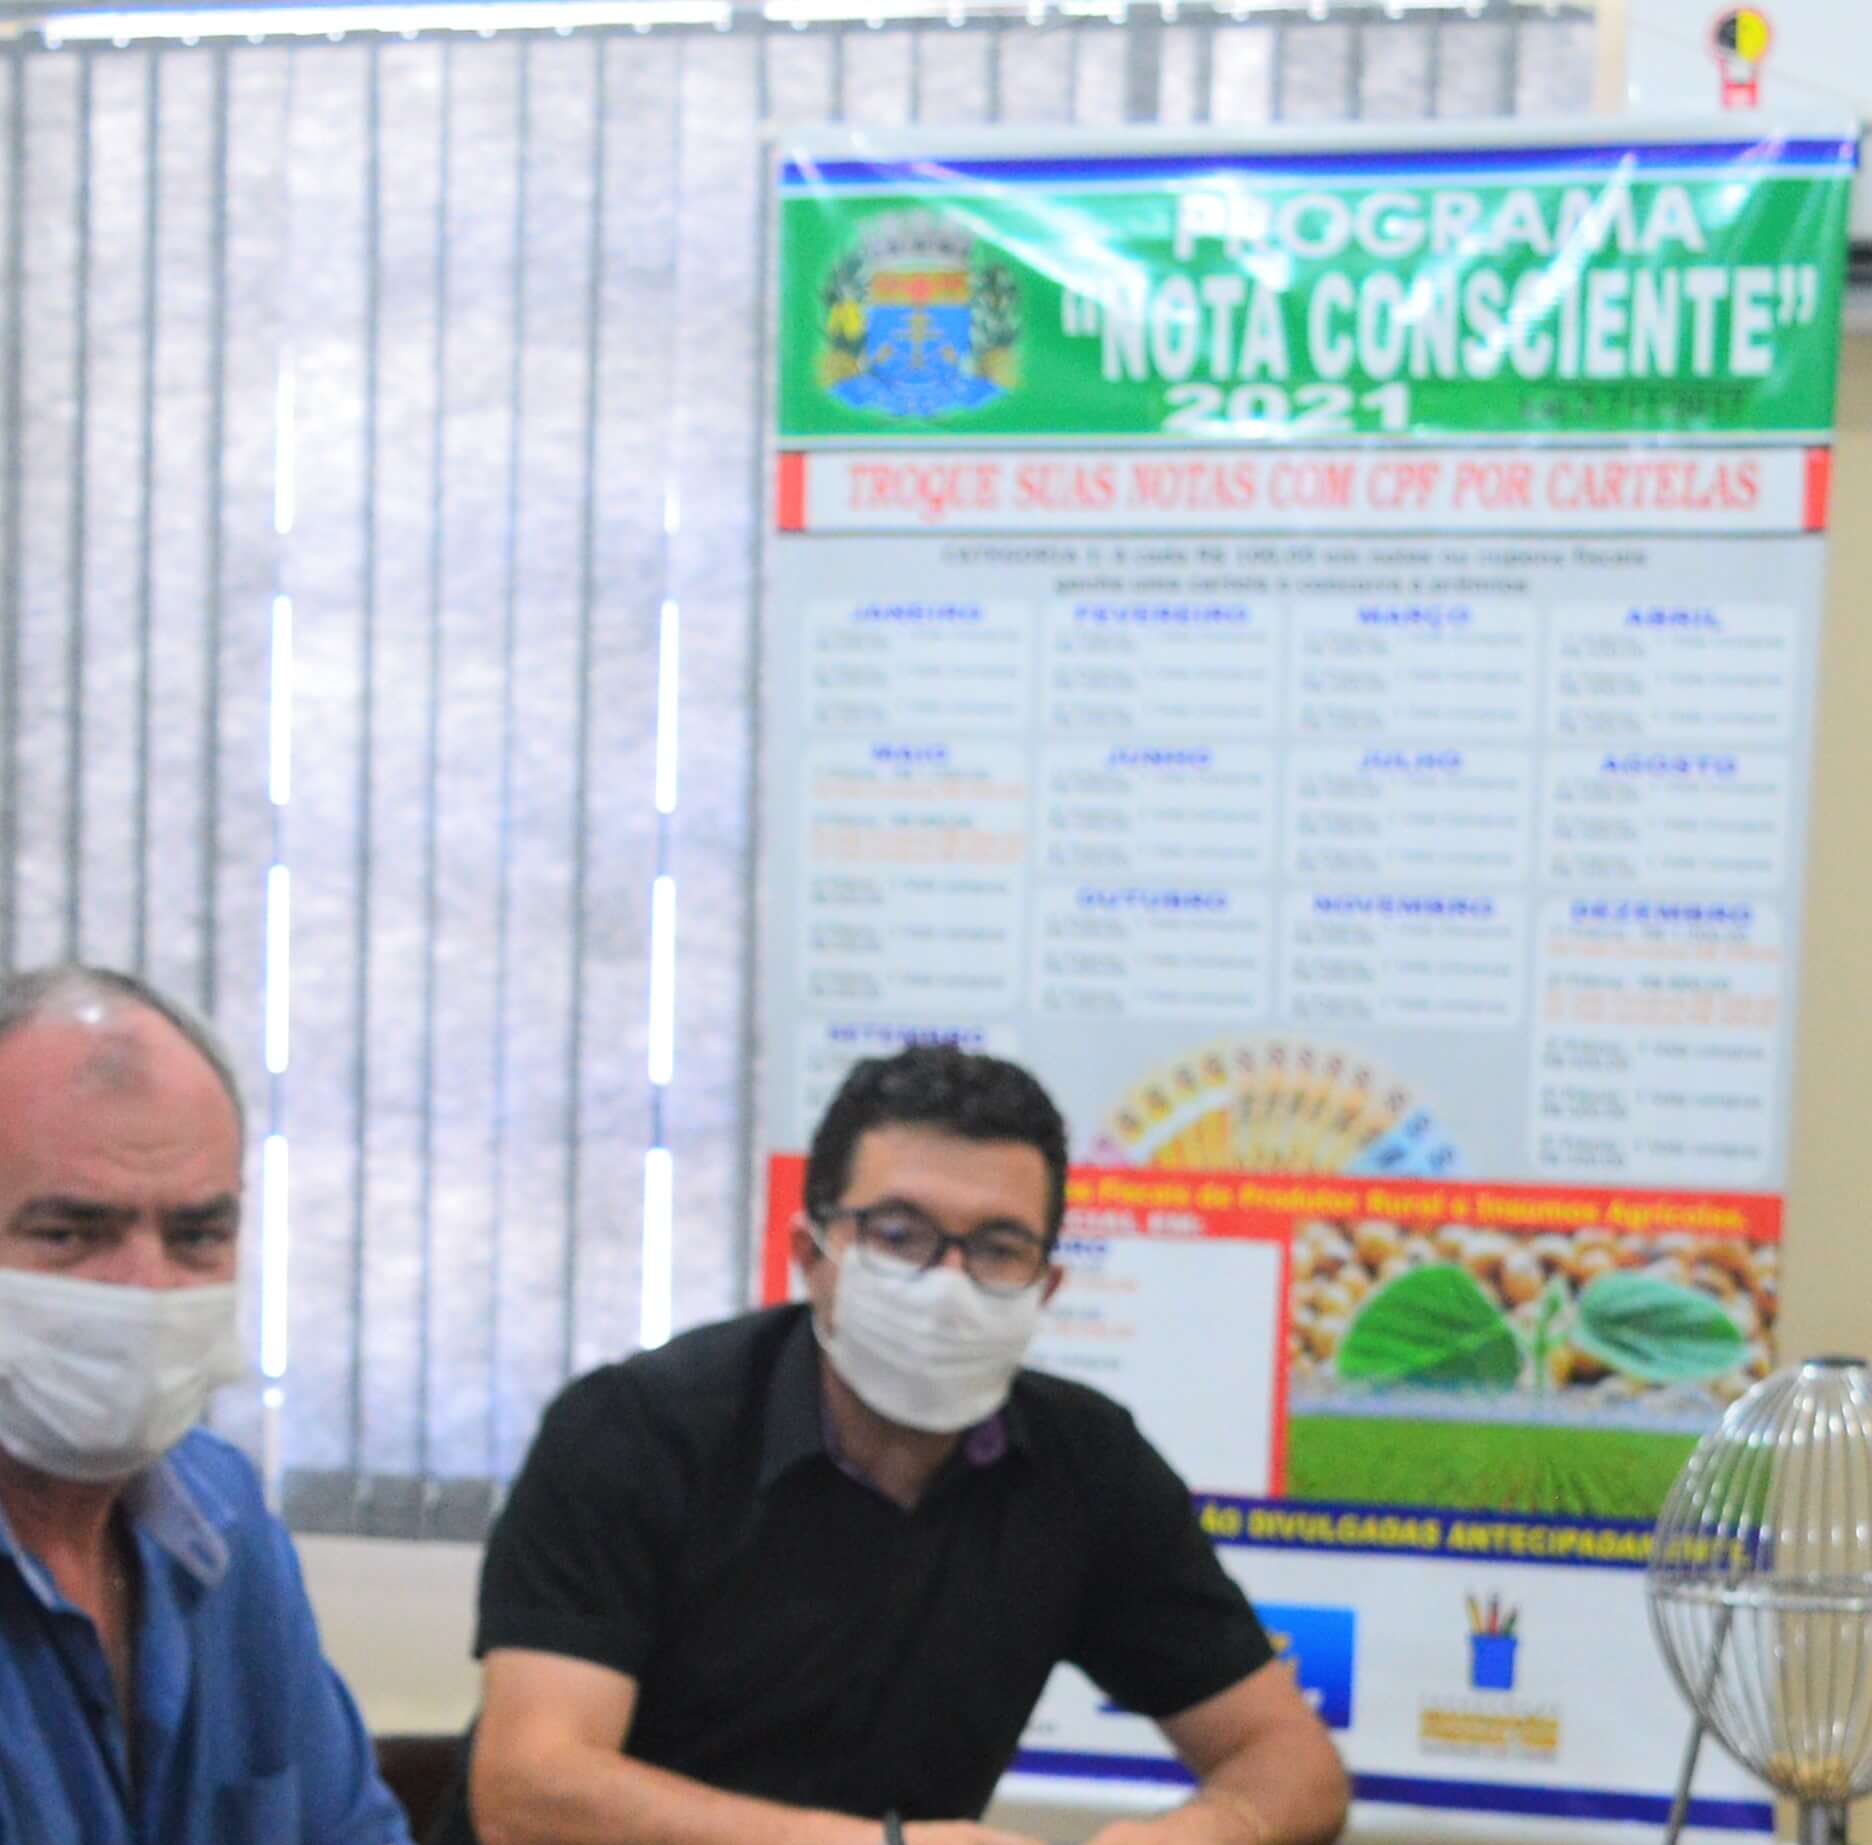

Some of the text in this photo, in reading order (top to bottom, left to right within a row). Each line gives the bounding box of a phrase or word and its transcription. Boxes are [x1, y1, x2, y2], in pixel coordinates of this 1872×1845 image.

[1173, 188, 1706, 260] PROGRAMA
[1162, 381, 1412, 434] 2021
[848, 461, 1761, 521] TROQUE SUAS NOTAS COM CPF POR CARTELAS
[1073, 602, 1251, 625] FEVEREIRO
[1356, 604, 1473, 630] MARÇO
[1625, 606, 1722, 629] ABRIL
[1600, 753, 1738, 776] AGOSTO
[1078, 886, 1229, 911] OUTUBRO
[1312, 894, 1494, 917] NOVEMBRO
[1570, 901, 1755, 924] DEZEMBRO
[1365, 1186, 1446, 1217] Rural
[1246, 1507, 1441, 1550] DIVULGADAS
